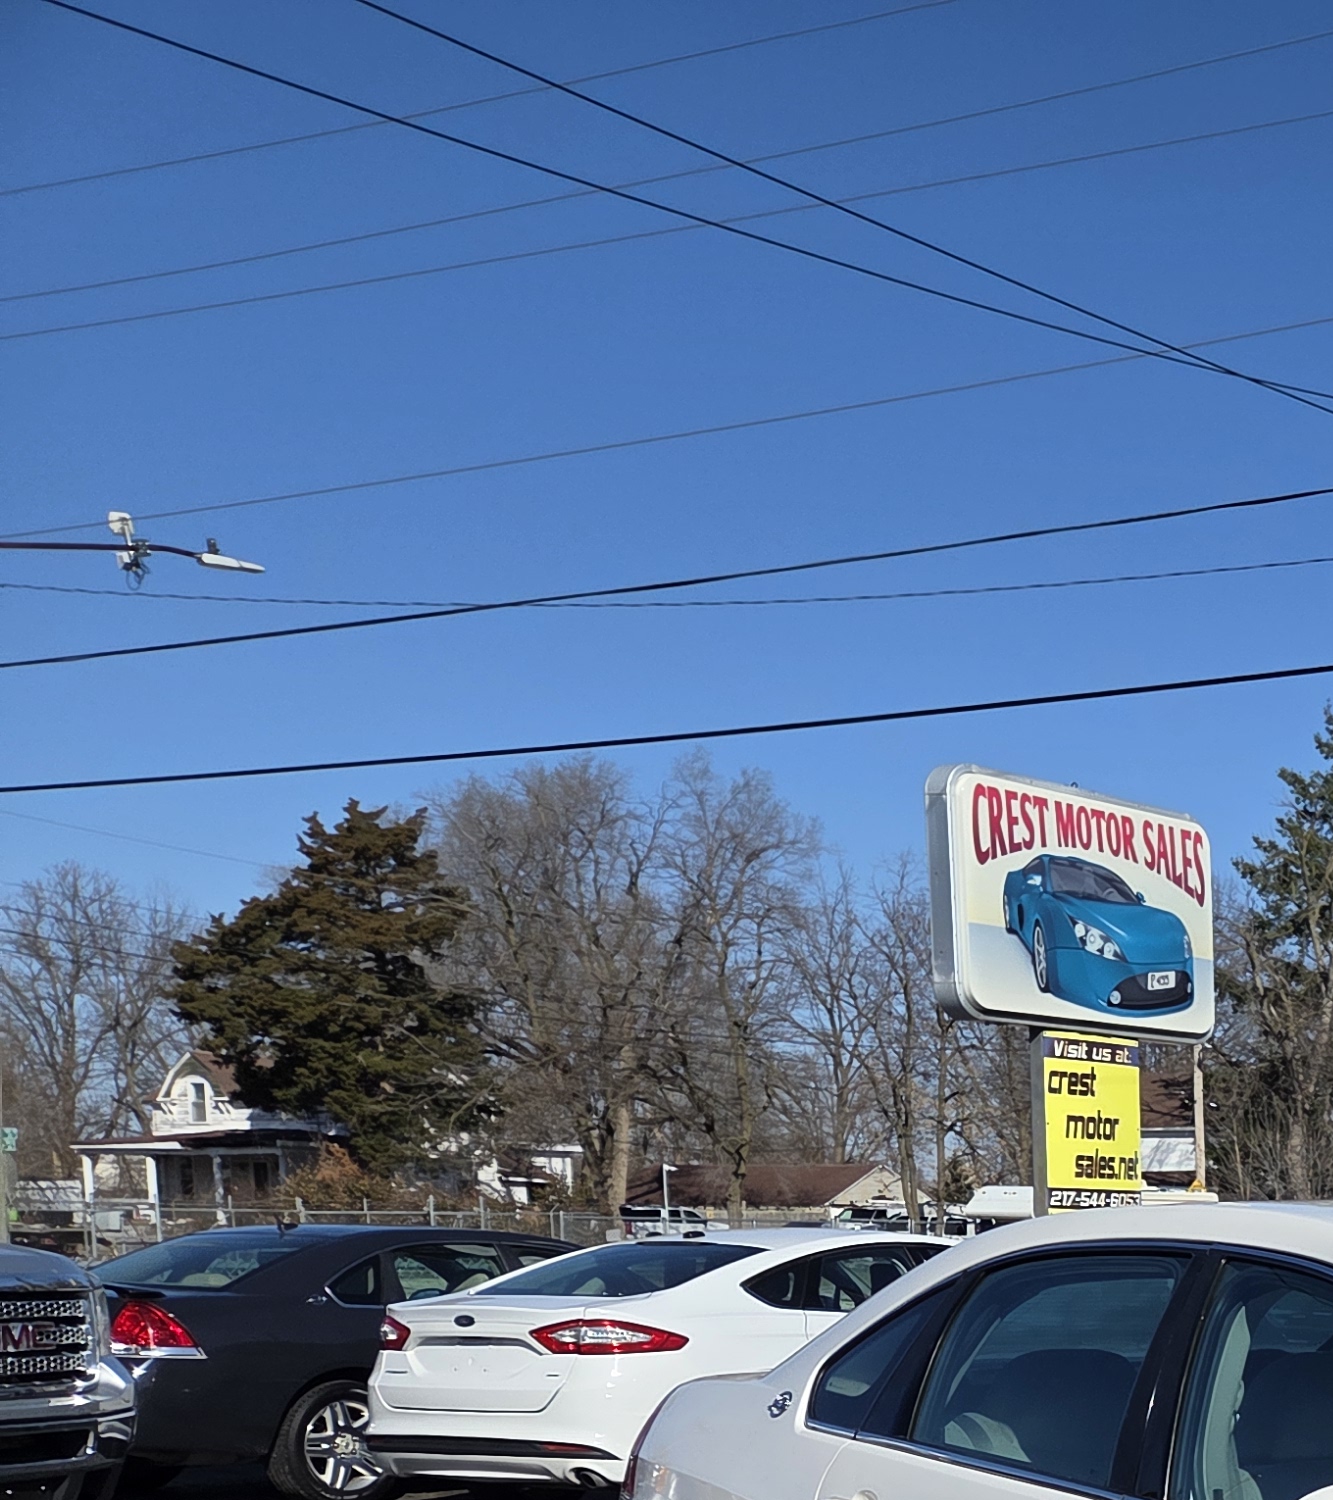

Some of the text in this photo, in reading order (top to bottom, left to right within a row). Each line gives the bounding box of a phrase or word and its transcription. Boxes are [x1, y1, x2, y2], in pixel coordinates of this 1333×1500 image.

[972, 783, 1205, 908] CREST MOTOR SALES
[1054, 1040, 1088, 1059] Visit
[1092, 1047, 1112, 1062] us
[1048, 1067, 1096, 1097] crest
[1066, 1110, 1120, 1141] motor
[1074, 1148, 1138, 1180] sales.net
[1050, 1190, 1140, 1207] 217-544-6053
[0, 1321, 56, 1352] MC
